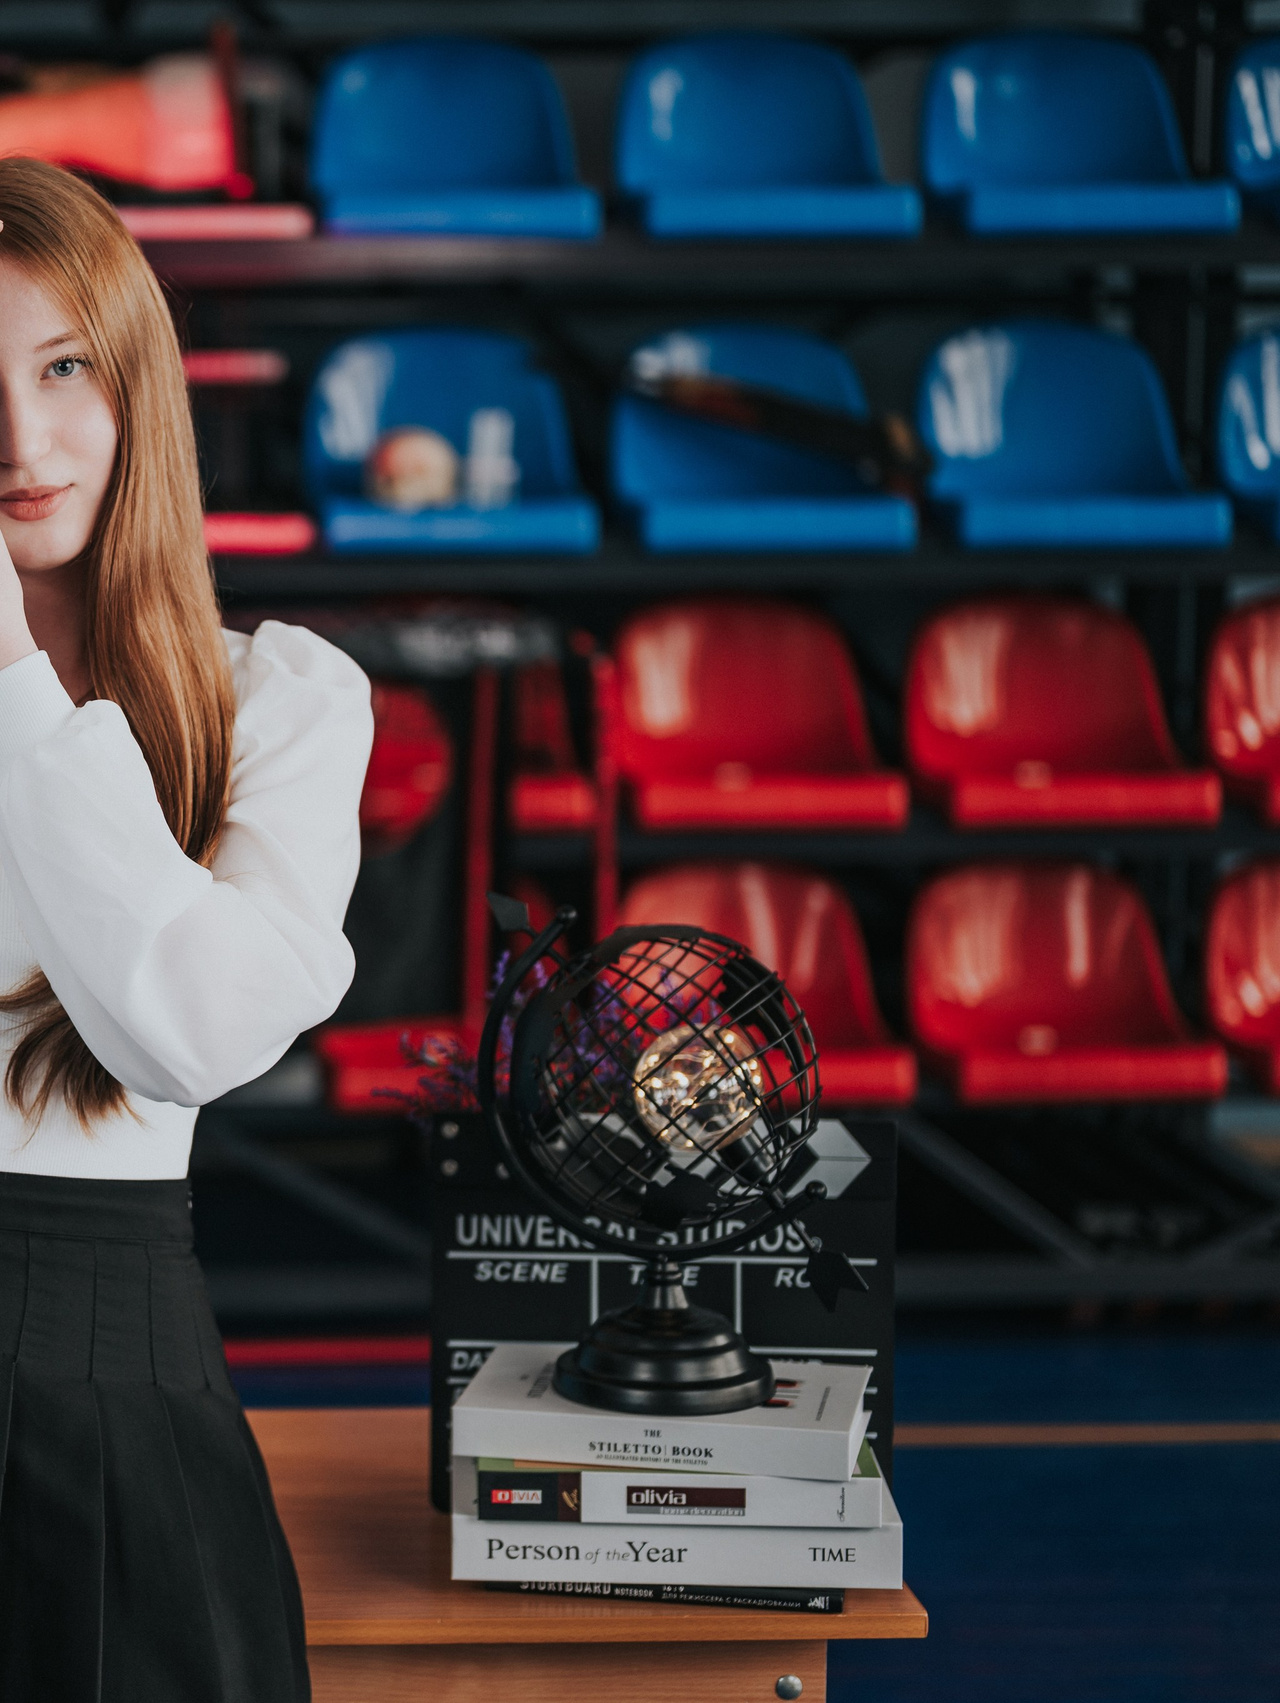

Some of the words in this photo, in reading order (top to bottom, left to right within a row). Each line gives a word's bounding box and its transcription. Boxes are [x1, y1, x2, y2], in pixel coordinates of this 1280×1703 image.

[475, 1260, 569, 1283] SCENE
[629, 1264, 701, 1287] TE
[451, 1351, 491, 1371] DA
[643, 1429, 662, 1438] THE
[588, 1441, 662, 1456] STILETTO
[672, 1446, 714, 1459] BOOK
[631, 1489, 687, 1505] olivia
[487, 1538, 581, 1560] Person
[585, 1548, 601, 1564] of
[606, 1548, 631, 1561] the
[626, 1541, 688, 1563] Year
[808, 1547, 856, 1562] TIME
[614, 1587, 654, 1598] NOTEBOOK
